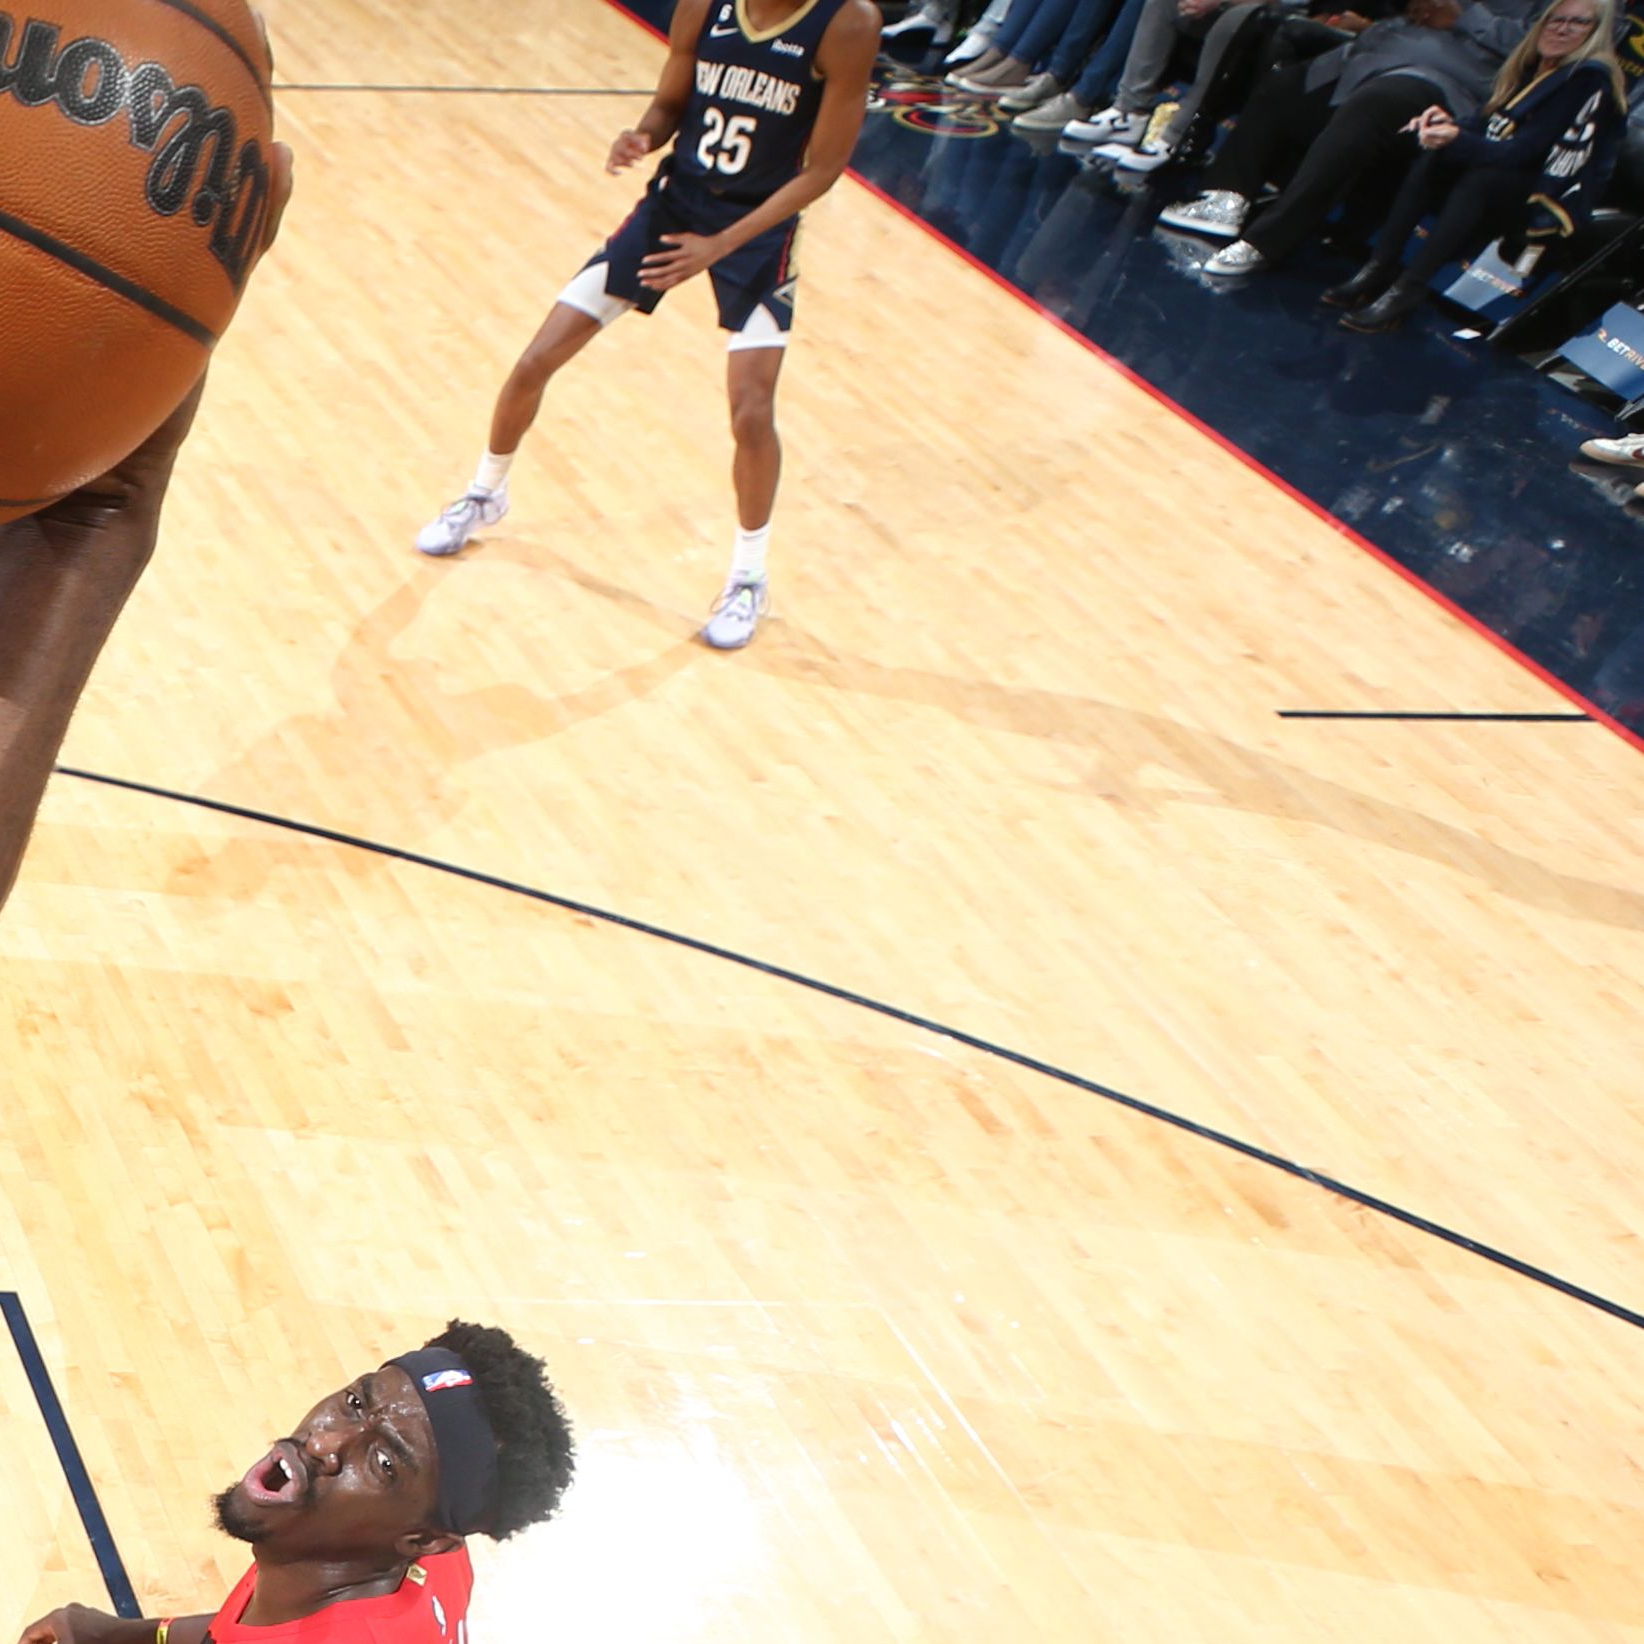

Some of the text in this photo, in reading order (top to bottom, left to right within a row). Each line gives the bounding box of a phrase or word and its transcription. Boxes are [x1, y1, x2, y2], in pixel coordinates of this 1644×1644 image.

[717, 4, 733, 22] 6
[719, 64, 801, 116] ORLEANS
[697, 106, 757, 175] 25
